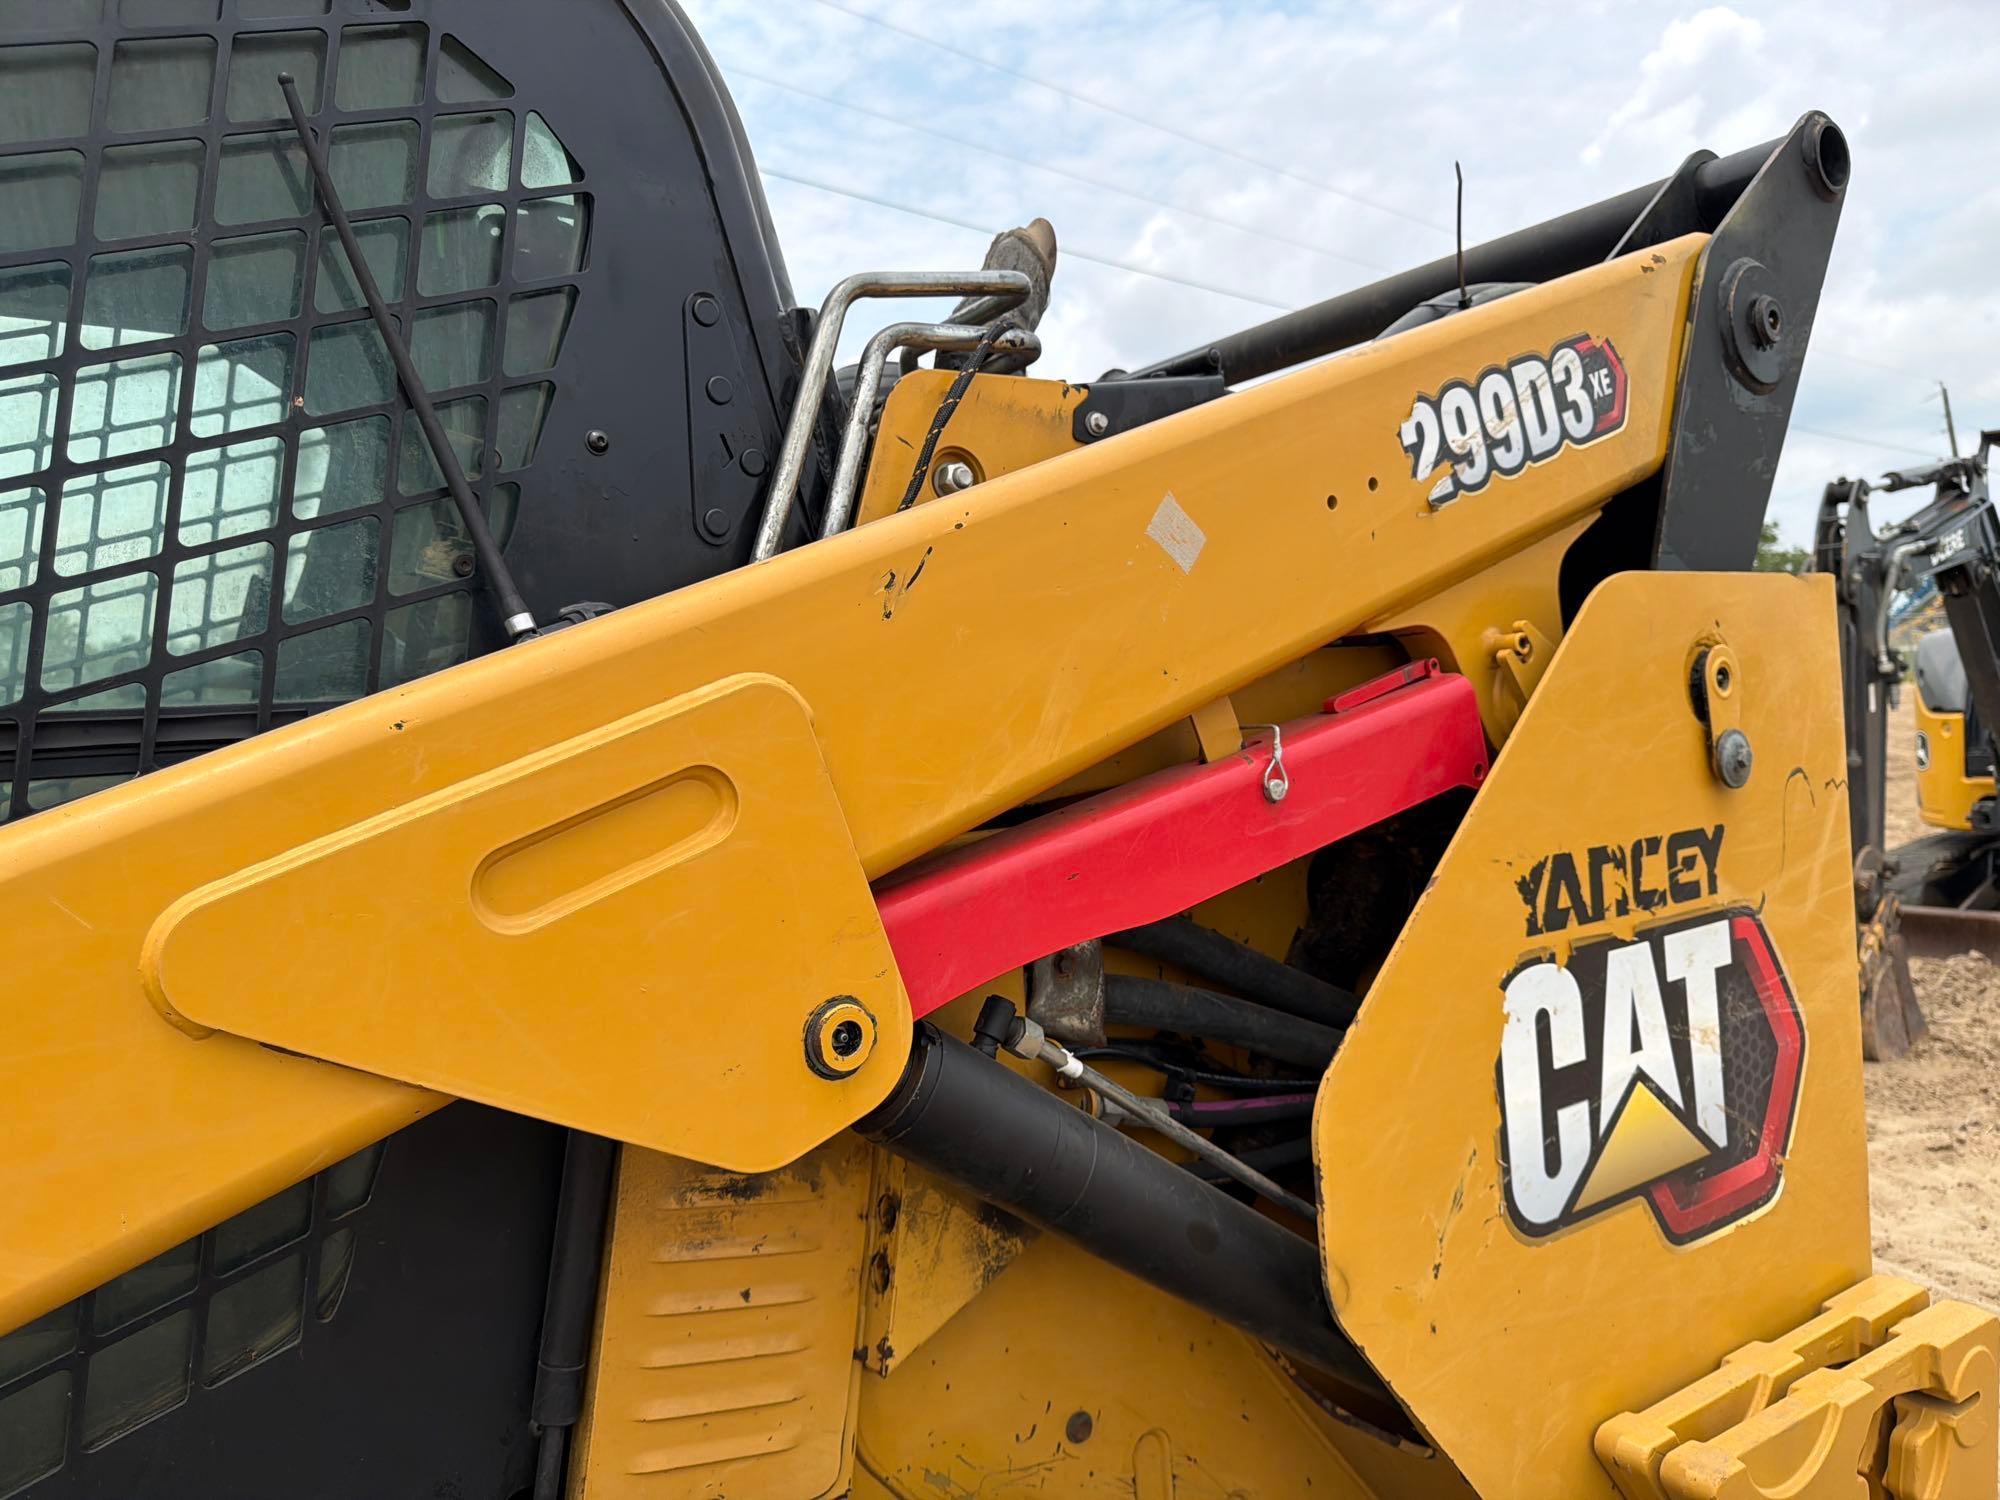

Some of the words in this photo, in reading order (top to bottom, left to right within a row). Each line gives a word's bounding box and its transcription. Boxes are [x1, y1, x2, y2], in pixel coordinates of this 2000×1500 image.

[1400, 347, 1595, 503] 299D3
[1588, 367, 1613, 400] XE
[1501, 919, 1732, 1224] CAT
